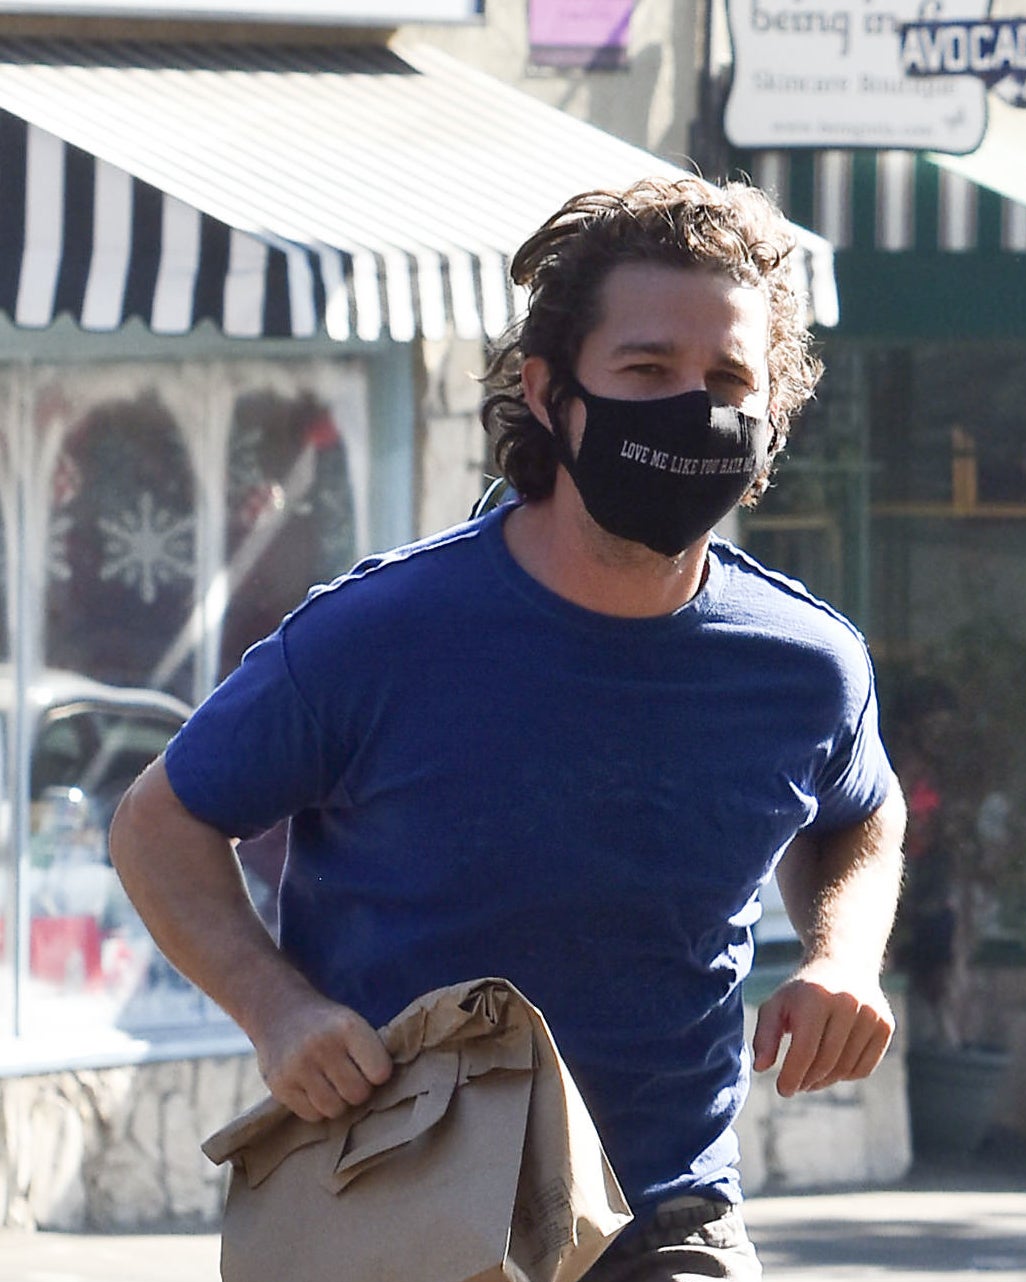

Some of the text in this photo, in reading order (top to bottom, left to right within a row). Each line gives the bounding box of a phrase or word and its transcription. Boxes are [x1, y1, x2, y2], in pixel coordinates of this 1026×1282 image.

[620, 440, 650, 463] LOVE
[650, 449, 669, 471] ME
[670, 455, 699, 475] LIKE
[700, 458, 721, 474] YOU
